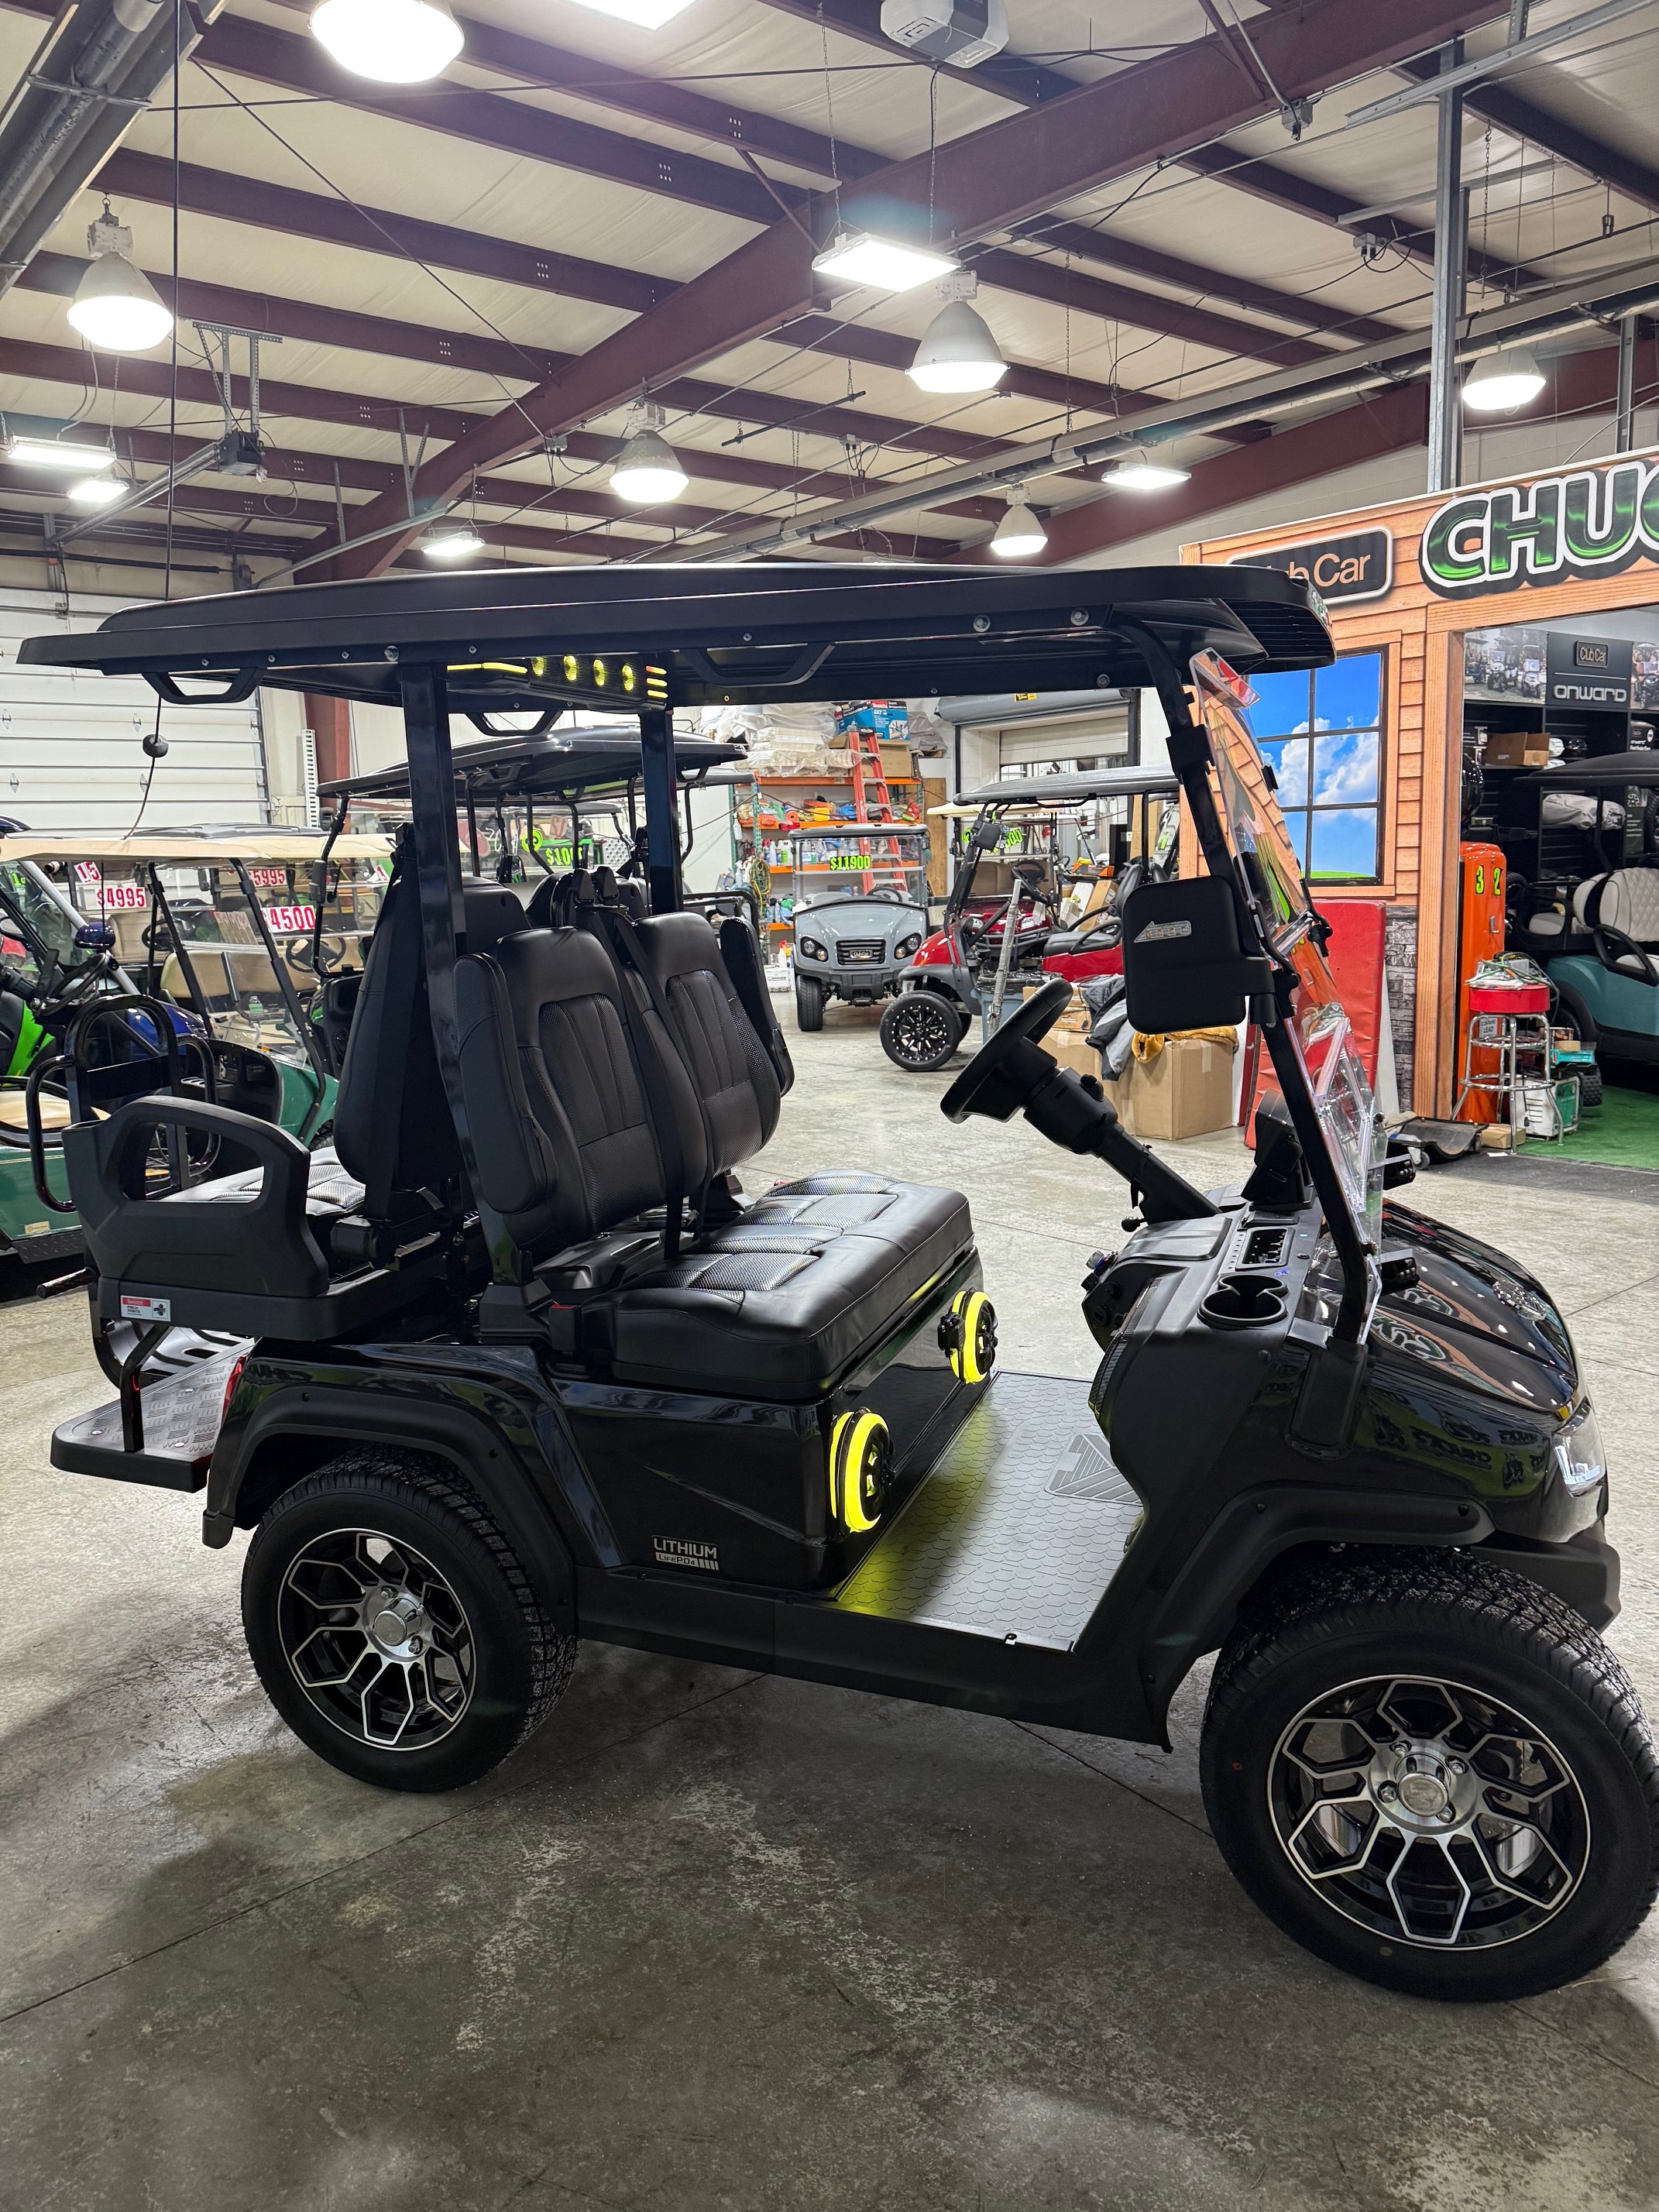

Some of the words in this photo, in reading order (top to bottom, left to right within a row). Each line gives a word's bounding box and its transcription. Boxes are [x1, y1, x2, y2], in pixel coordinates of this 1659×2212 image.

[1313, 552, 1371, 587] Car
[1579, 646, 1594, 662] Club
[1594, 647, 1606, 662] Car
[97, 888, 146, 908] $4995
[262, 906, 316, 931] 4500
[653, 1537, 717, 1559] LITHIUM
